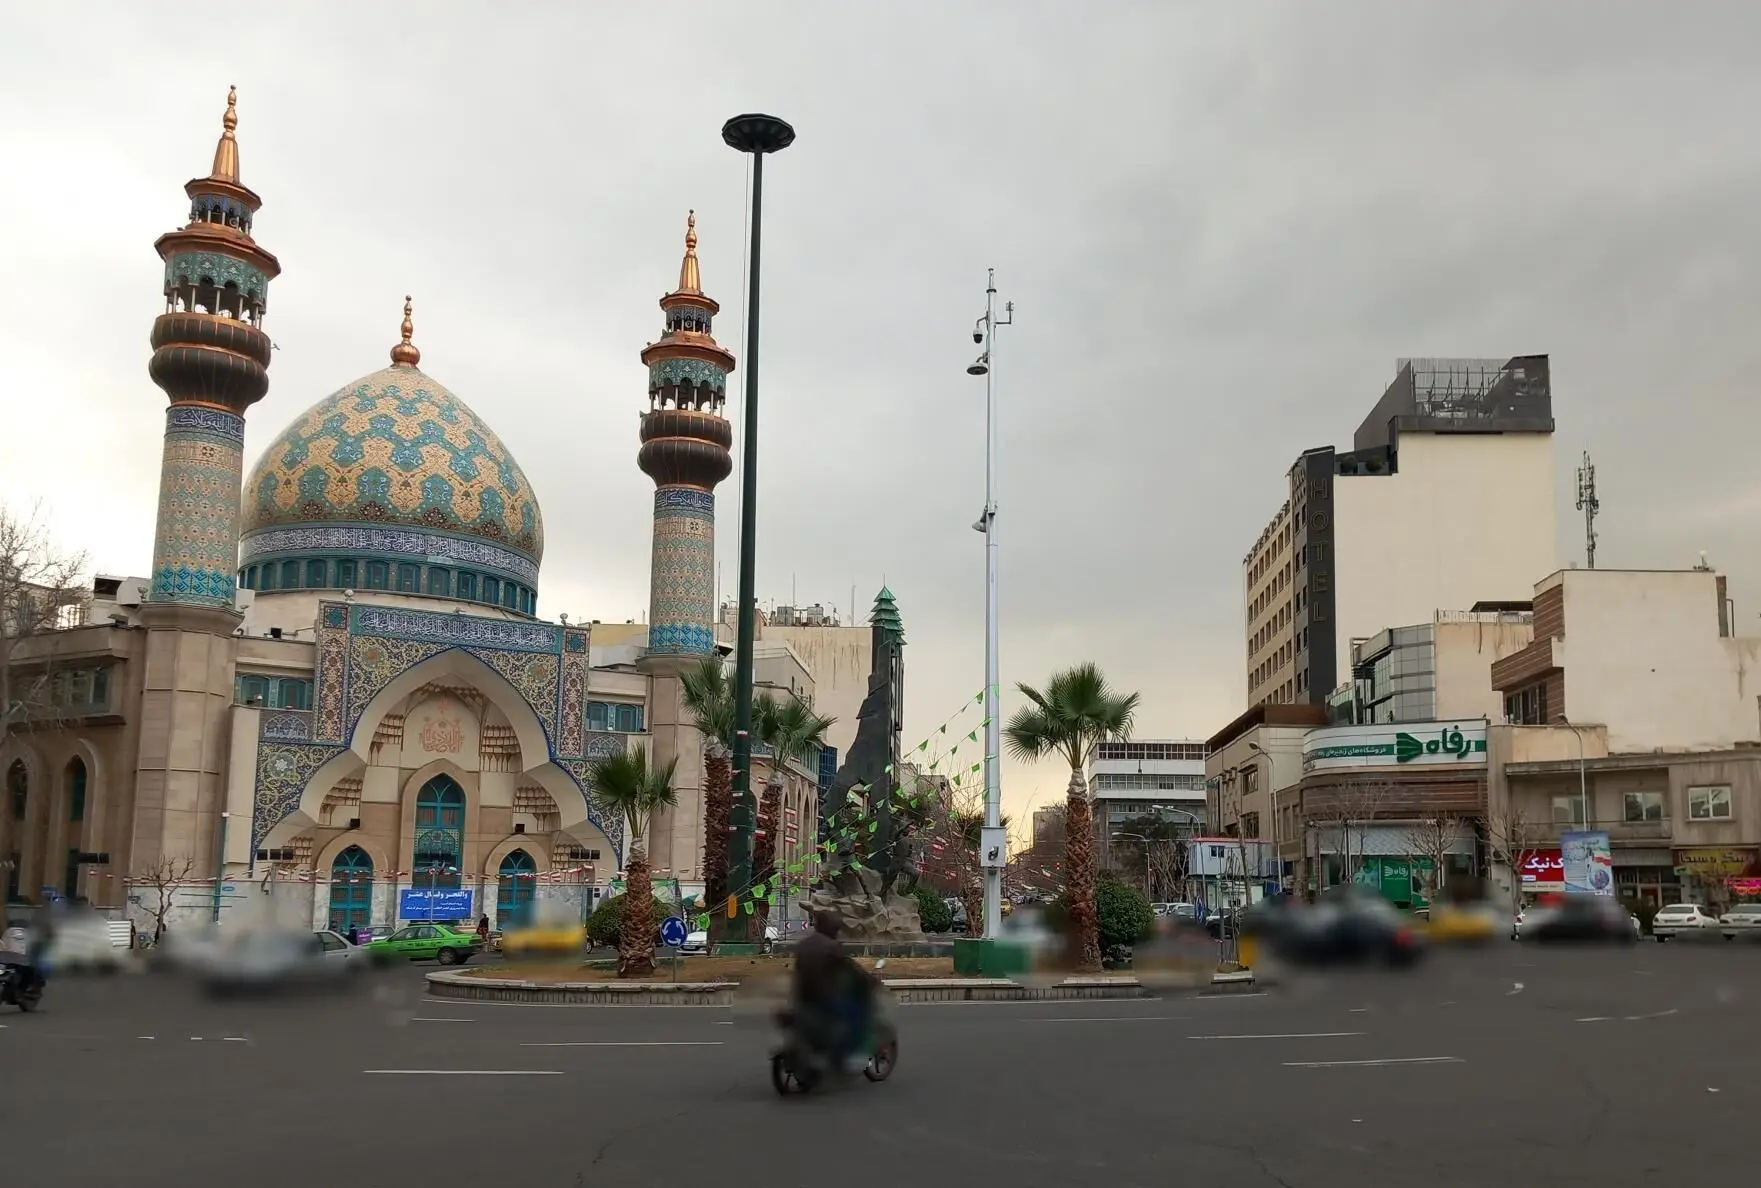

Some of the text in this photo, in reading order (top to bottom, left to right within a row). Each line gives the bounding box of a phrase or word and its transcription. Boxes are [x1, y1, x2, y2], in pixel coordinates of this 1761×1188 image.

[1310, 477, 1328, 622] HOTEL
[1426, 724, 1472, 759] رفاه
[1525, 857, 1550, 872] نیک
[407, 891, 424, 899] عشر
[424, 890, 444, 901] ولال
